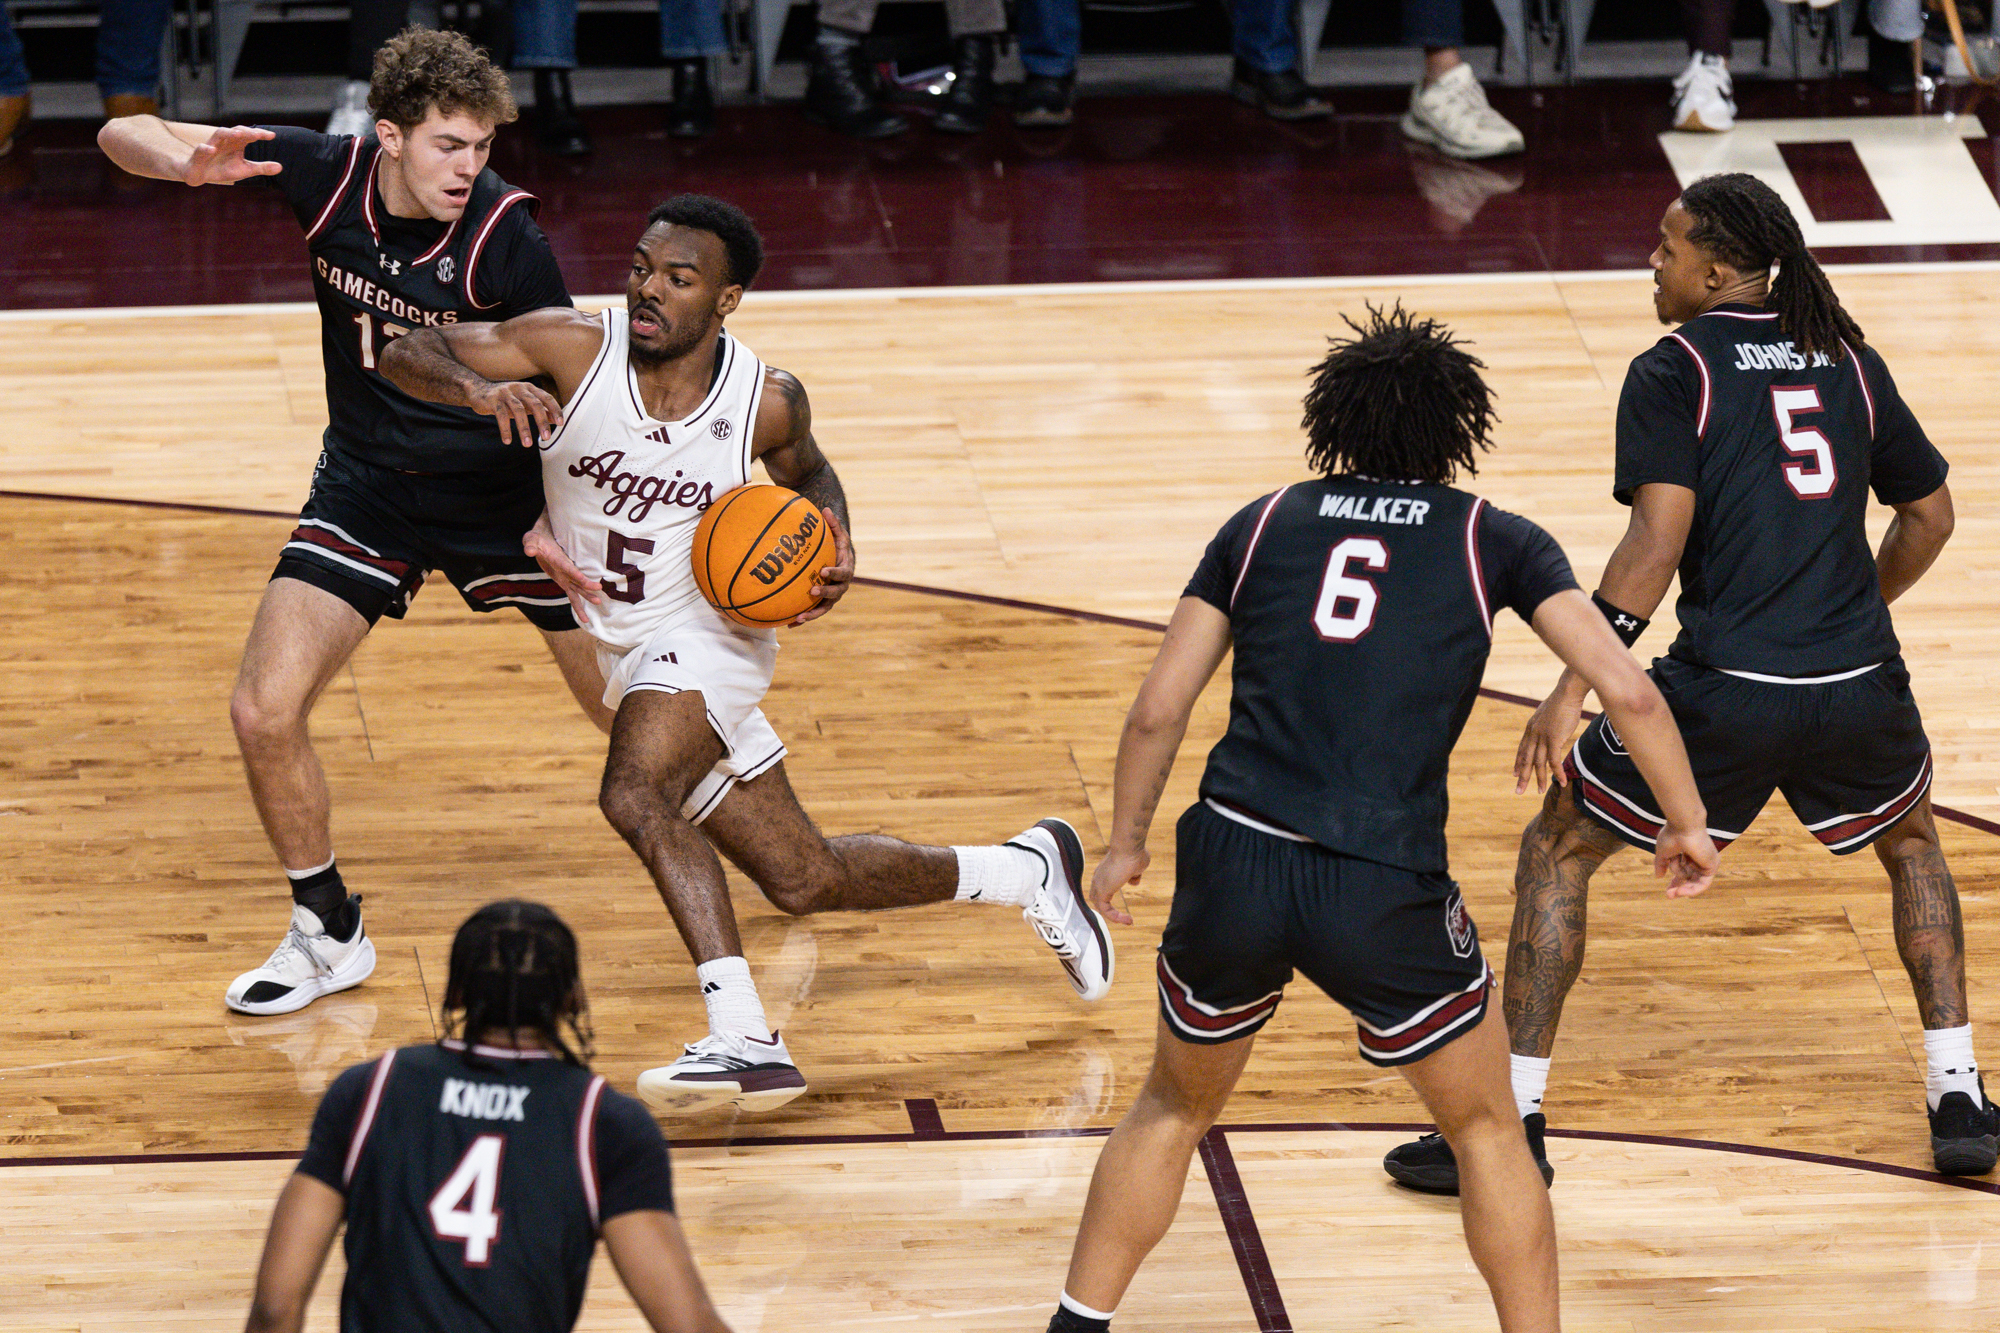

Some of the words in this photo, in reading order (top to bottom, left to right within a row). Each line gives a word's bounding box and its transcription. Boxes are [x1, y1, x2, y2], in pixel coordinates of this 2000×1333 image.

[316, 256, 459, 327] GAMECOCKS
[436, 256, 456, 284] SEC
[352, 311, 411, 372] 1
[712, 420, 730, 438] SEC
[1770, 384, 1839, 500] 5
[568, 450, 715, 524] Aggies
[1319, 494, 1431, 525] WALKER
[600, 529, 656, 605] 5
[749, 512, 819, 585] Wilson
[1310, 534, 1391, 645] 6
[440, 1077, 531, 1122] KNOX
[428, 1133, 507, 1268] 4
